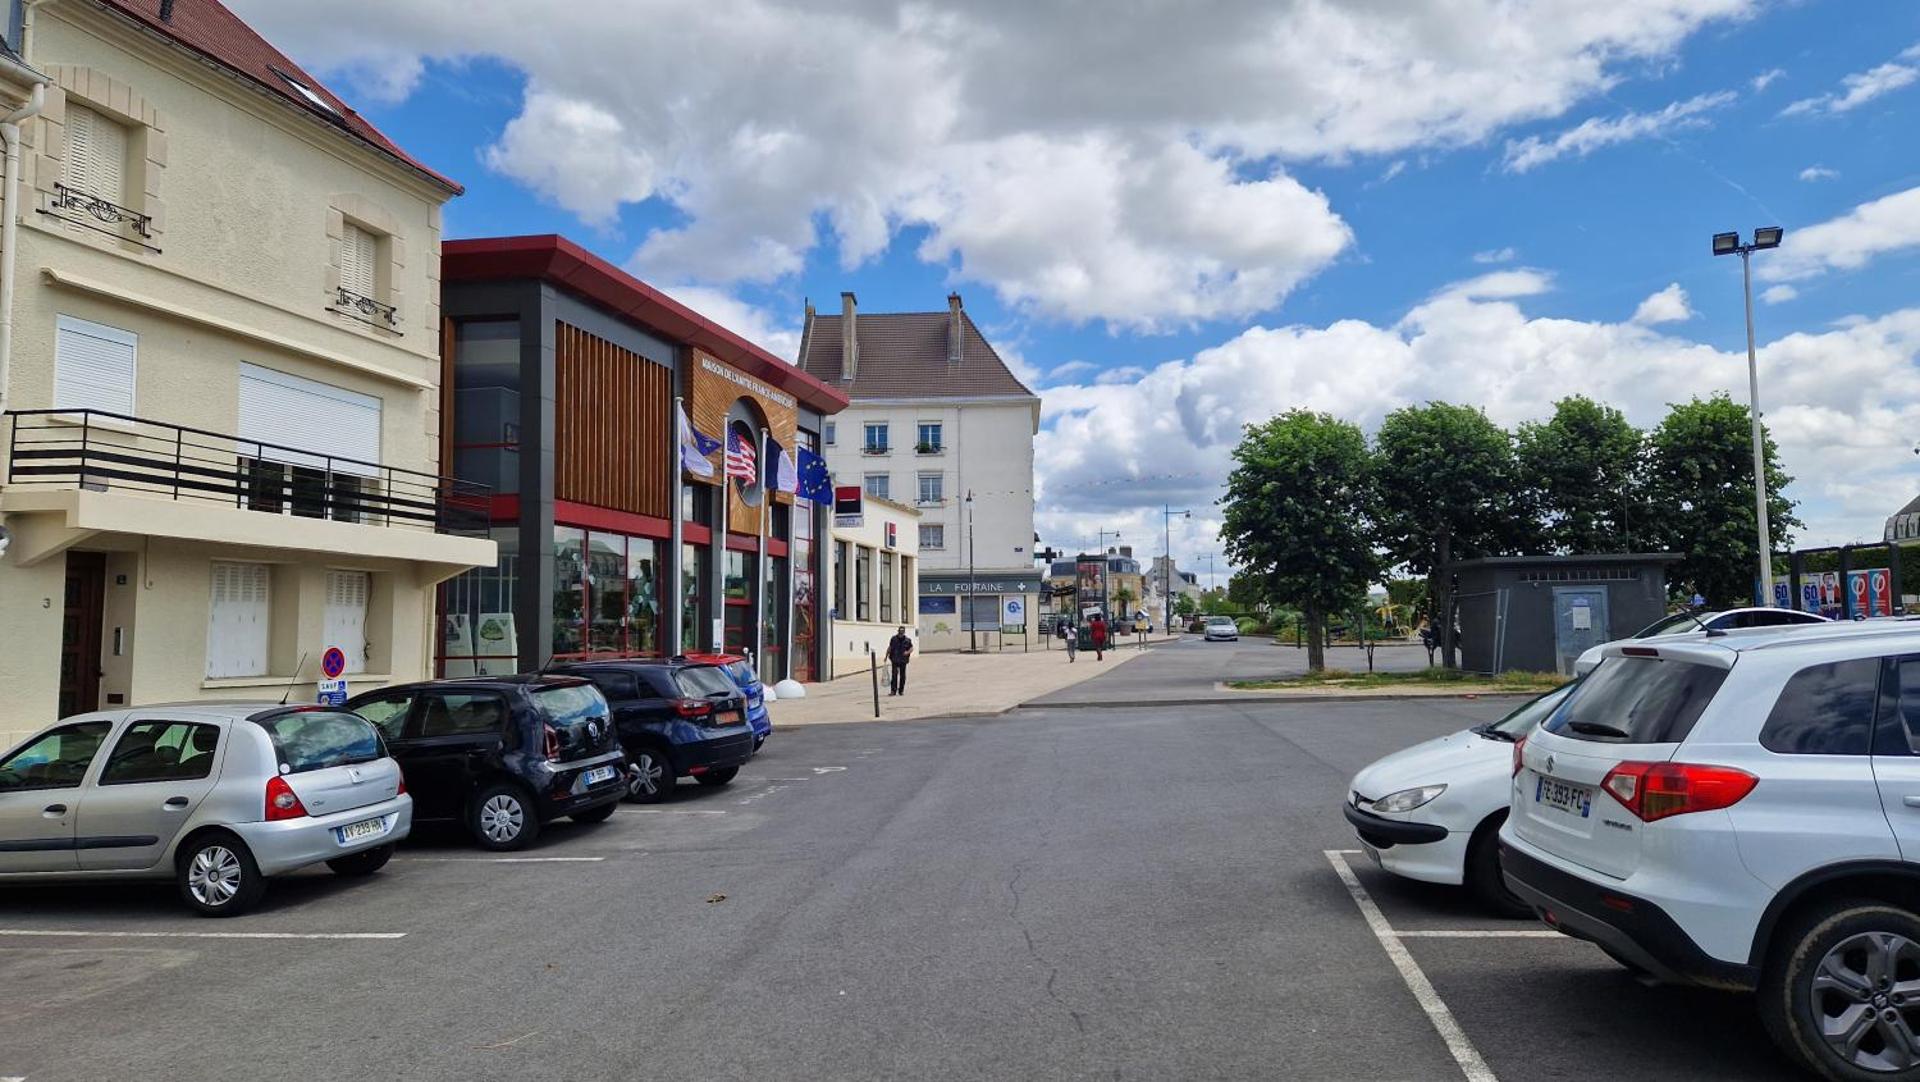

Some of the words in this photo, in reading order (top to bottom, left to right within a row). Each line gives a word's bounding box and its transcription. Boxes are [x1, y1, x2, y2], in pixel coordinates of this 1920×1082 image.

[702, 358, 724, 377] MAISON
[929, 584, 942, 592] LA
[1775, 584, 1788, 600] 60
[1804, 584, 1817, 600] 60
[43, 598, 51, 609] 3
